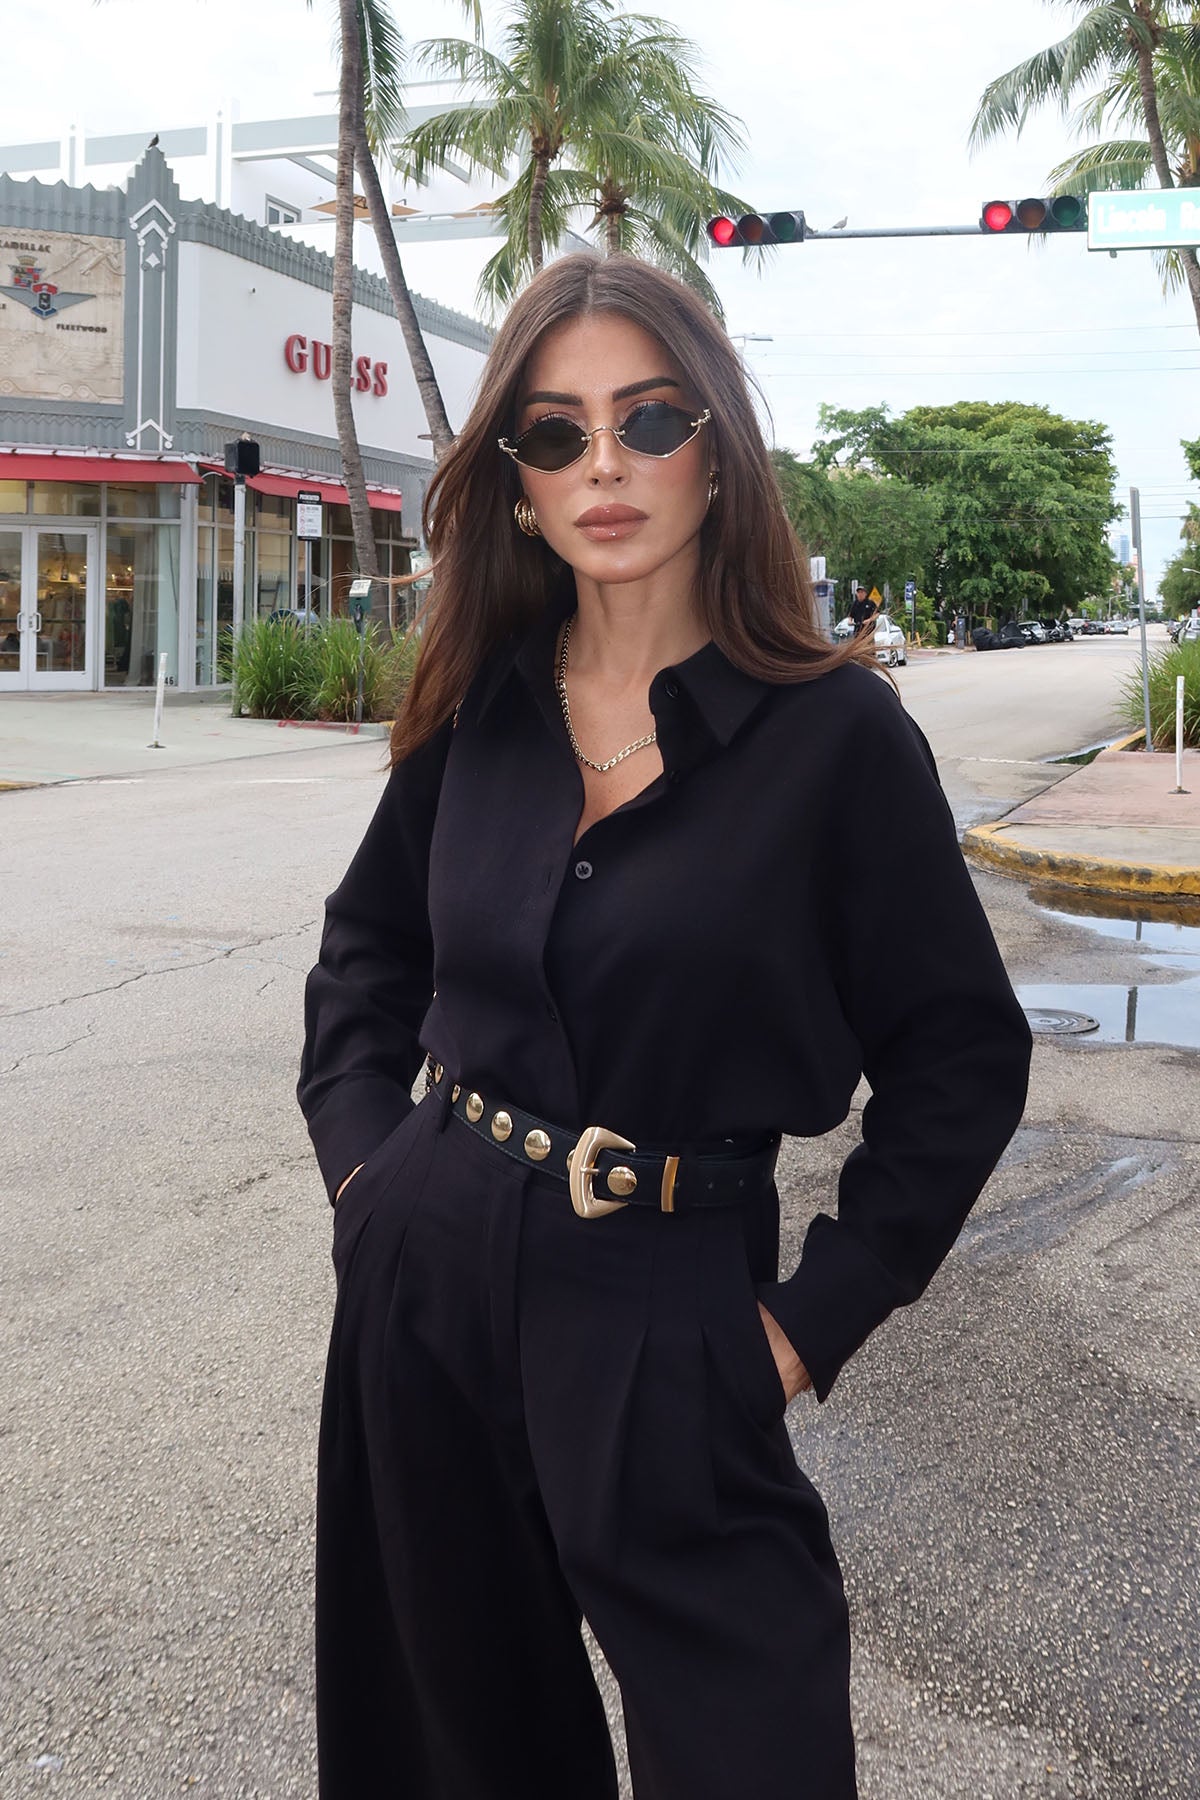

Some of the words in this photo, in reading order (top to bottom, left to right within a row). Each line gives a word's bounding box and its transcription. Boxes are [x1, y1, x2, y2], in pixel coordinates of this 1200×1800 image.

[1097, 203, 1166, 233] Lincoln
[56, 323, 108, 334] FLEETWOOD
[284, 333, 388, 397] GUSS
